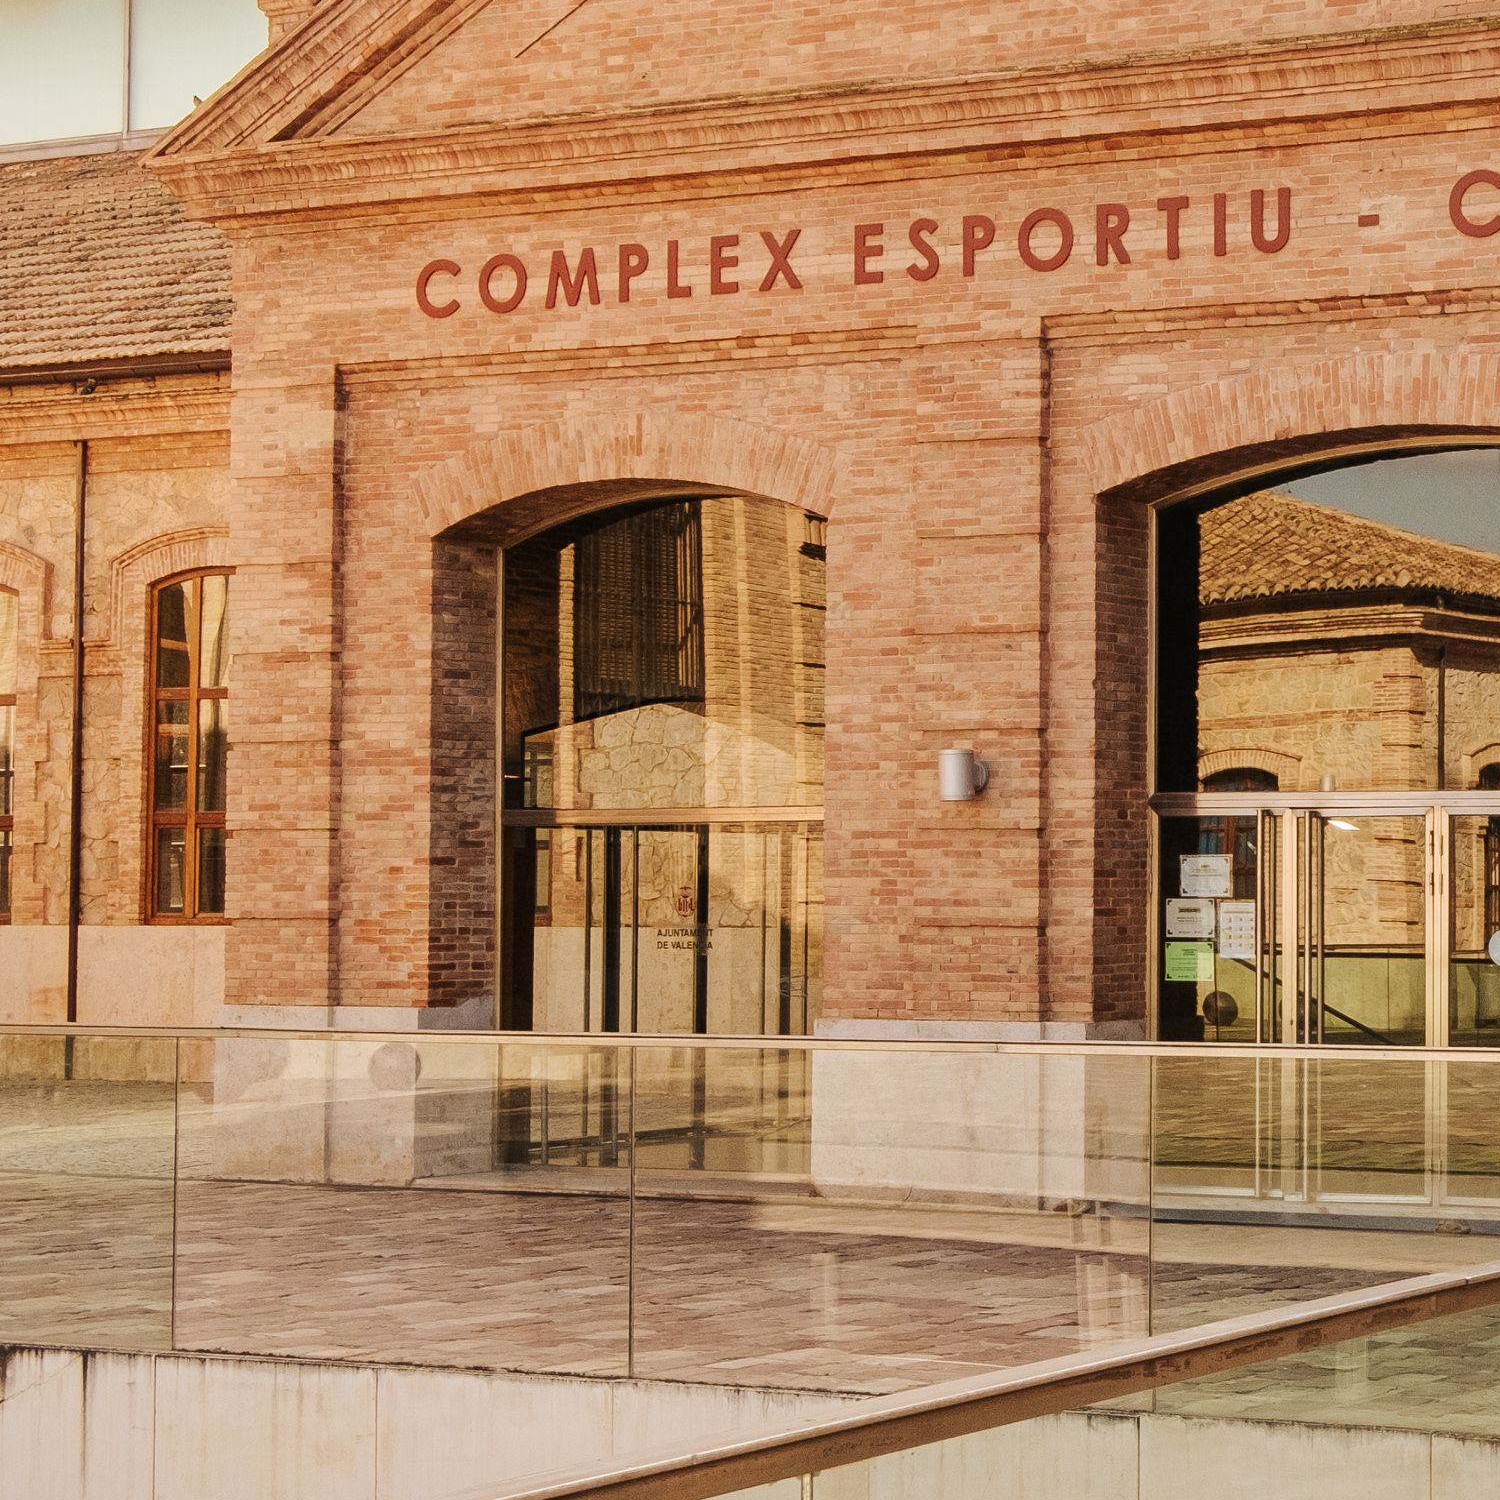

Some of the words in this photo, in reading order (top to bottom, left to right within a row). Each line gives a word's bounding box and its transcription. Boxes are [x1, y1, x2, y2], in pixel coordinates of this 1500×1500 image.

[416, 229, 803, 319] COMPLEX
[853, 187, 1292, 286] ESPORTIU
[656, 928, 714, 938] AJUNTAMNT
[656, 940, 669, 950] DE
[671, 940, 714, 950] VALENIA
